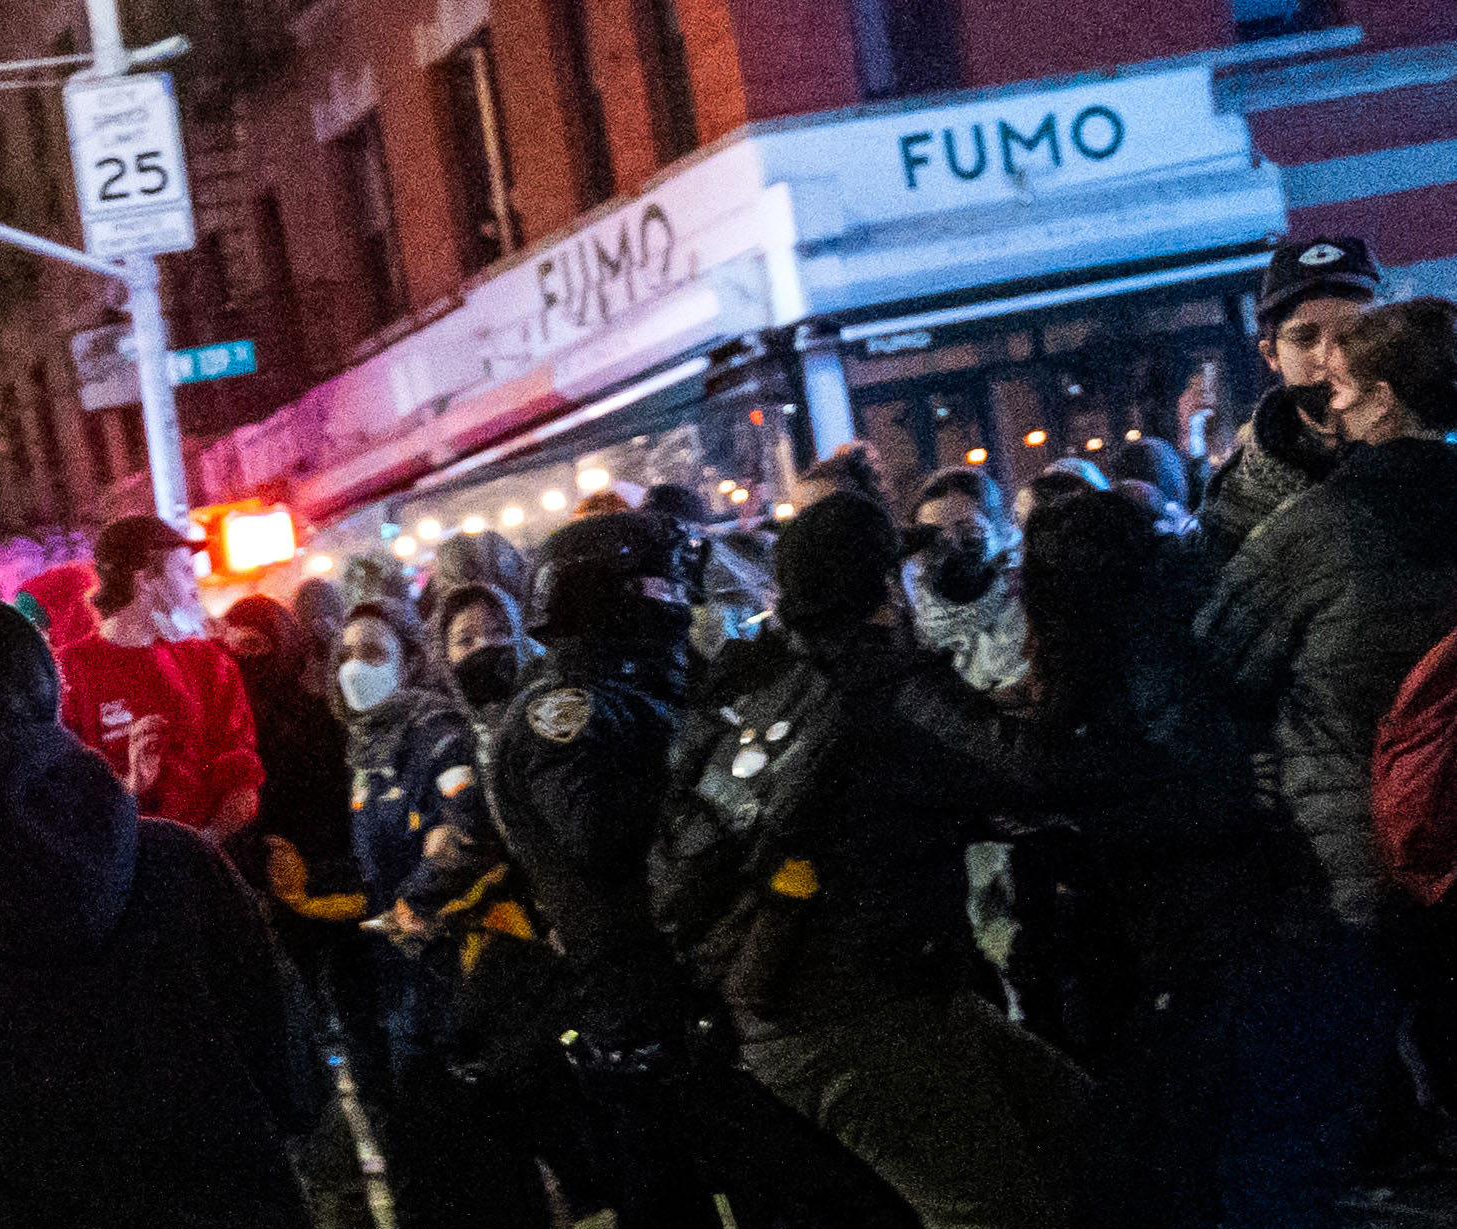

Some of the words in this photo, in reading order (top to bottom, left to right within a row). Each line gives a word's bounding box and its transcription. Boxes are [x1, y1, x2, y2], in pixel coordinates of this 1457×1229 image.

[95, 150, 168, 202] 25
[900, 103, 1124, 189] FUMO
[536, 202, 675, 342] FUMO
